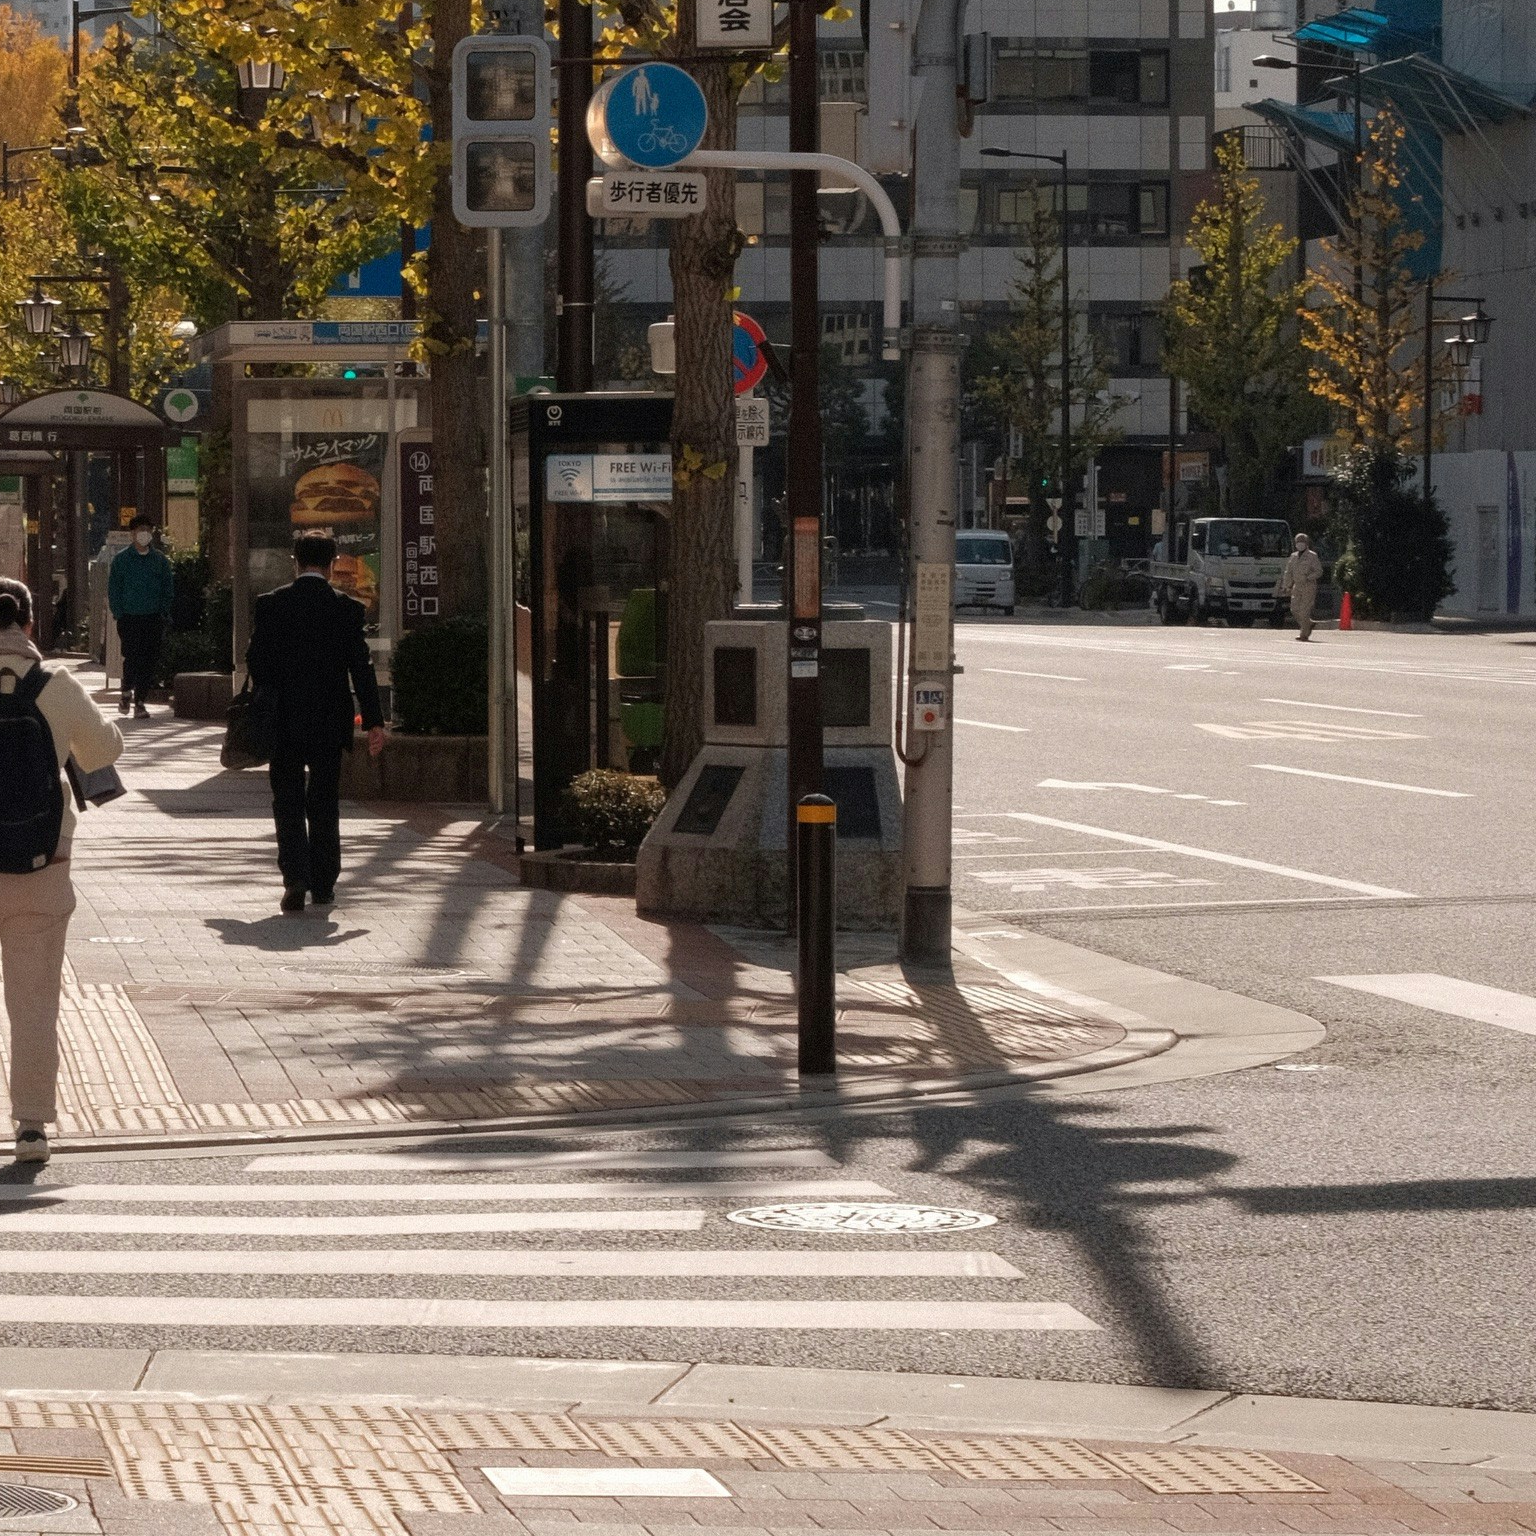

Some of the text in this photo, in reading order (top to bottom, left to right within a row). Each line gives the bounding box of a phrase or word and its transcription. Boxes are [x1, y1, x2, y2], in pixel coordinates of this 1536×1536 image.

[610, 180, 698, 204] 歩行者優先
[288, 434, 378, 463] サムライマック
[610, 462, 671, 474] FREE Wi-Fi
